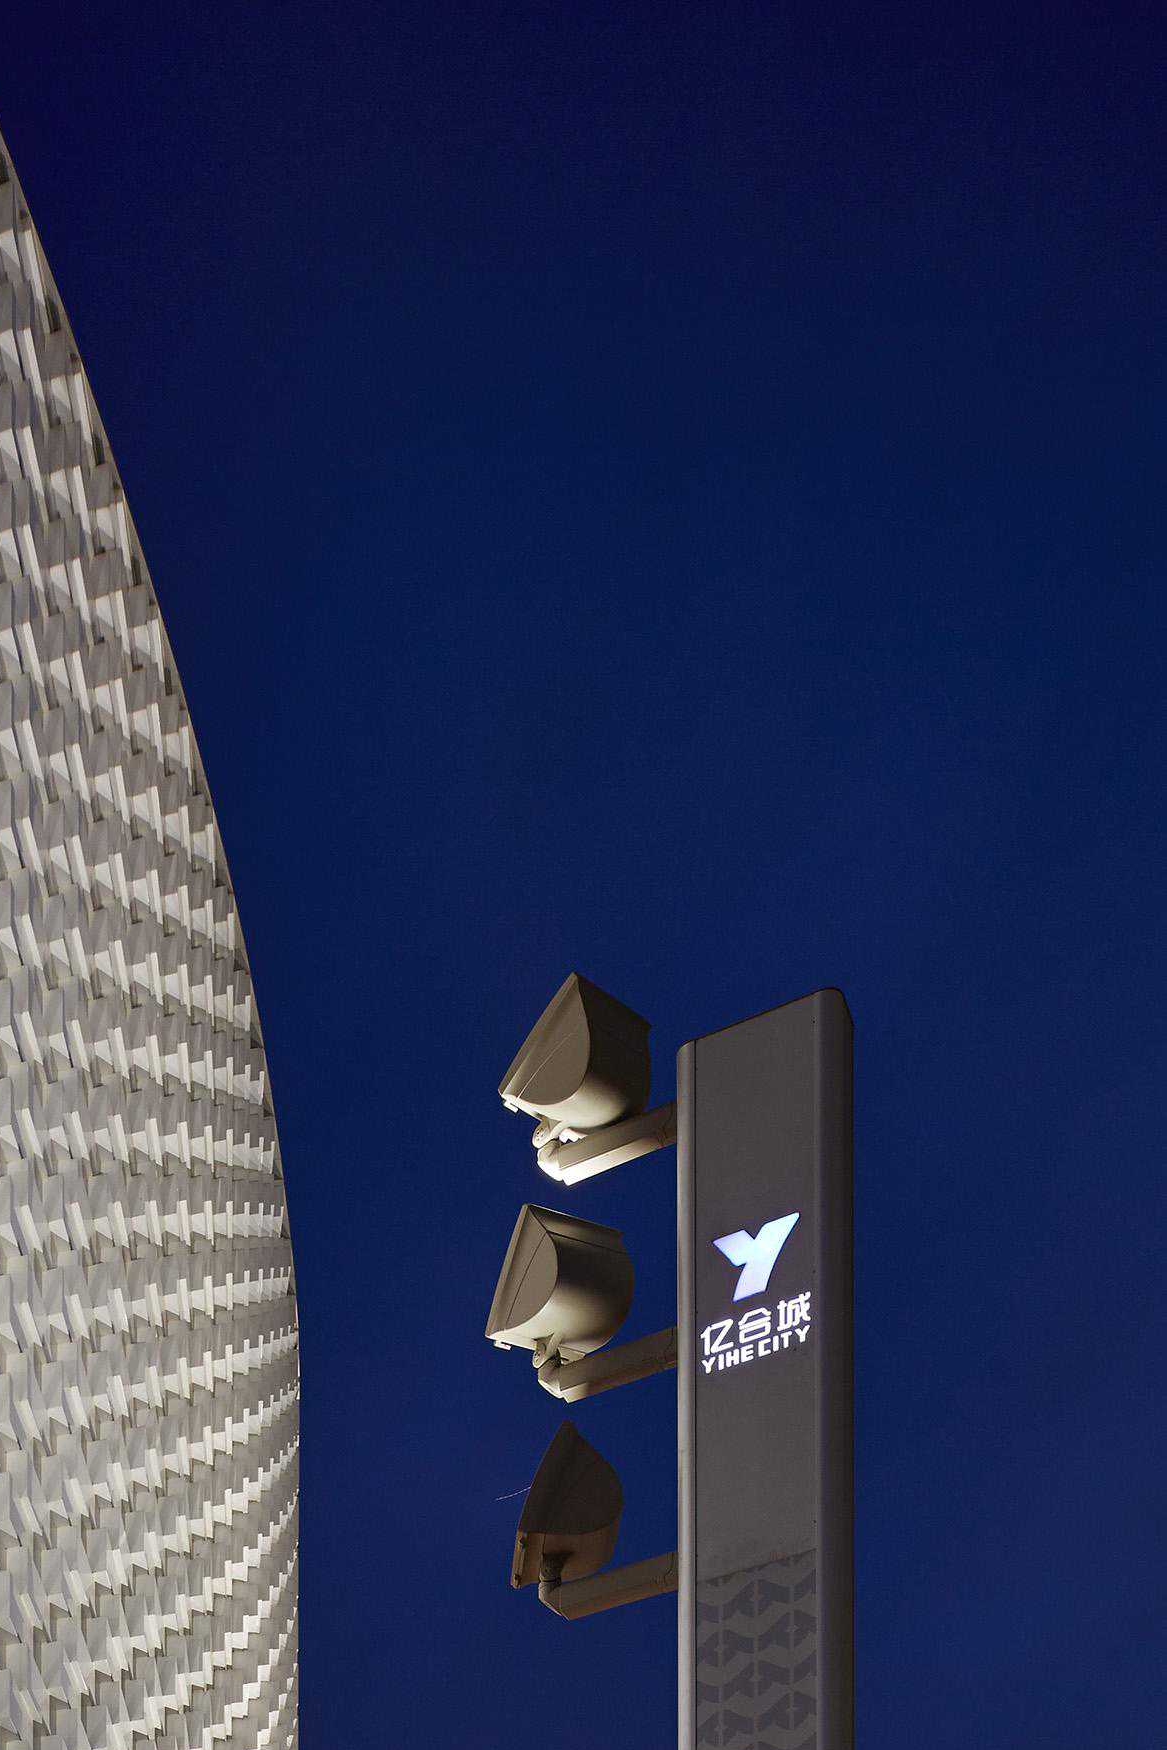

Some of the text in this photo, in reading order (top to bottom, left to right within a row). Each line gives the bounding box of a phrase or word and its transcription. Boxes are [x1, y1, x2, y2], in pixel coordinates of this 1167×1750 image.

[700, 1291, 811, 1356] 亿合城
[701, 1324, 810, 1374] YIHE CITY
